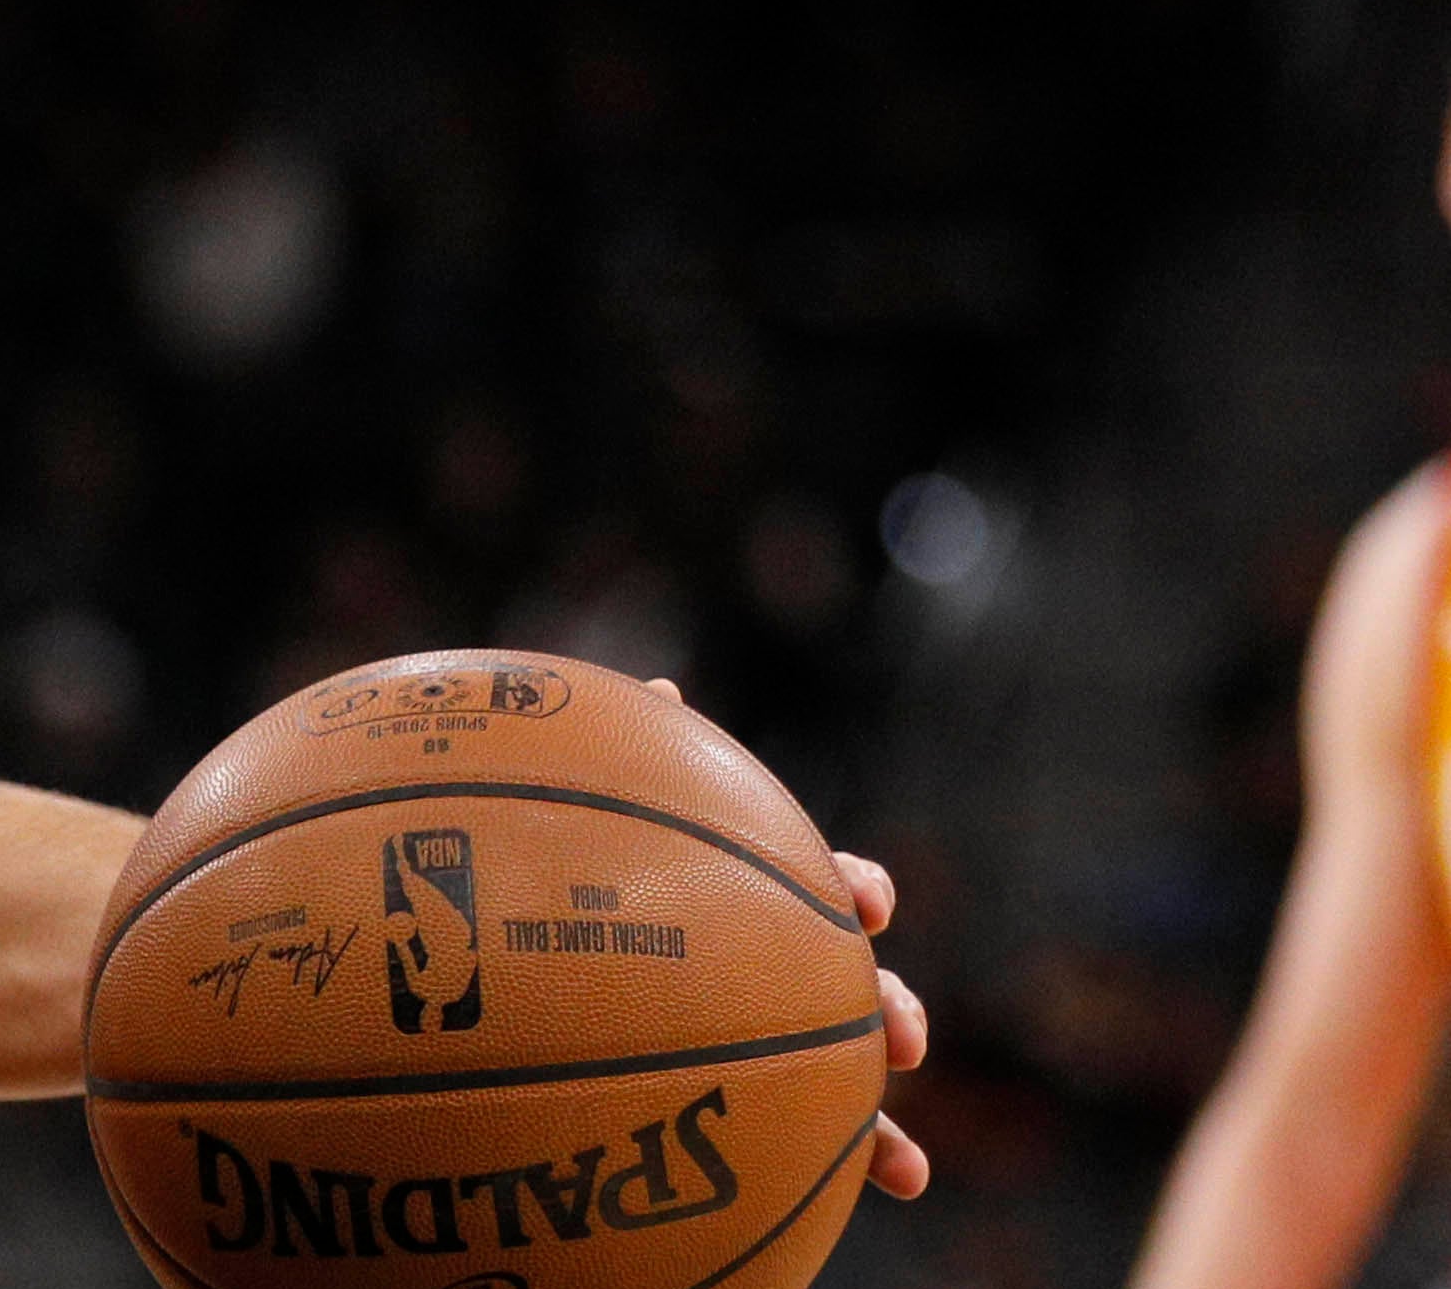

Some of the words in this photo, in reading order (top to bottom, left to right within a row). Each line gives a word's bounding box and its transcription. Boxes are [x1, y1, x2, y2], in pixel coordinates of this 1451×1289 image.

[416, 838, 462, 870] NBA
[502, 920, 549, 952] BALL
[553, 920, 605, 953] GAME
[609, 922, 685, 959] OFFICIAL
[195, 1086, 739, 1258] SPALDING
